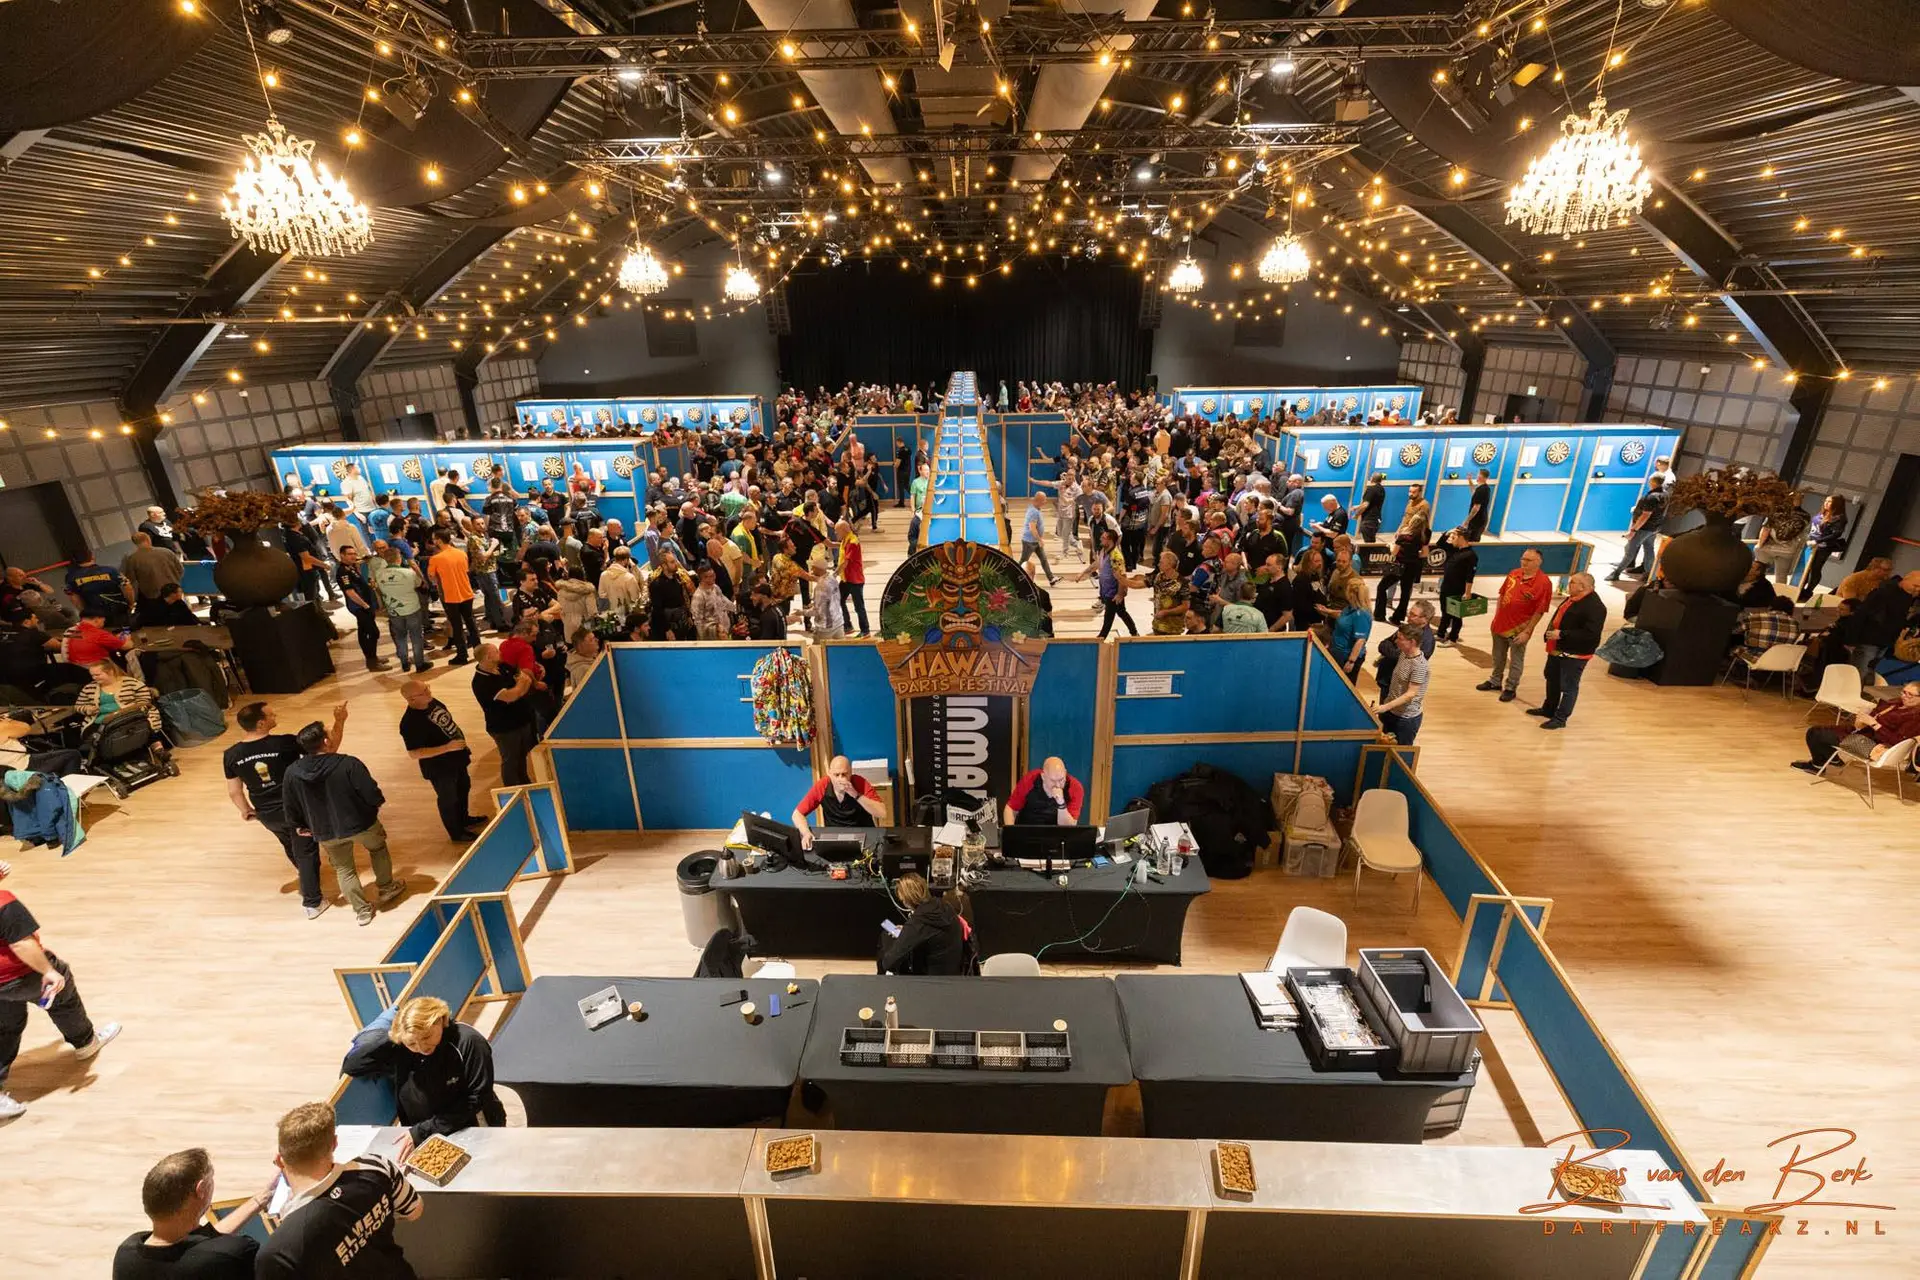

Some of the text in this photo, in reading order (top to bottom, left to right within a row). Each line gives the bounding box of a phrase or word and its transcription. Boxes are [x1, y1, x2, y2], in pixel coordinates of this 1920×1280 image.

[908, 651, 1018, 679] HAWAII
[897, 678, 1028, 694] DARTS FESTIVAL
[933, 695, 942, 796] ORCE BEHIND DAR
